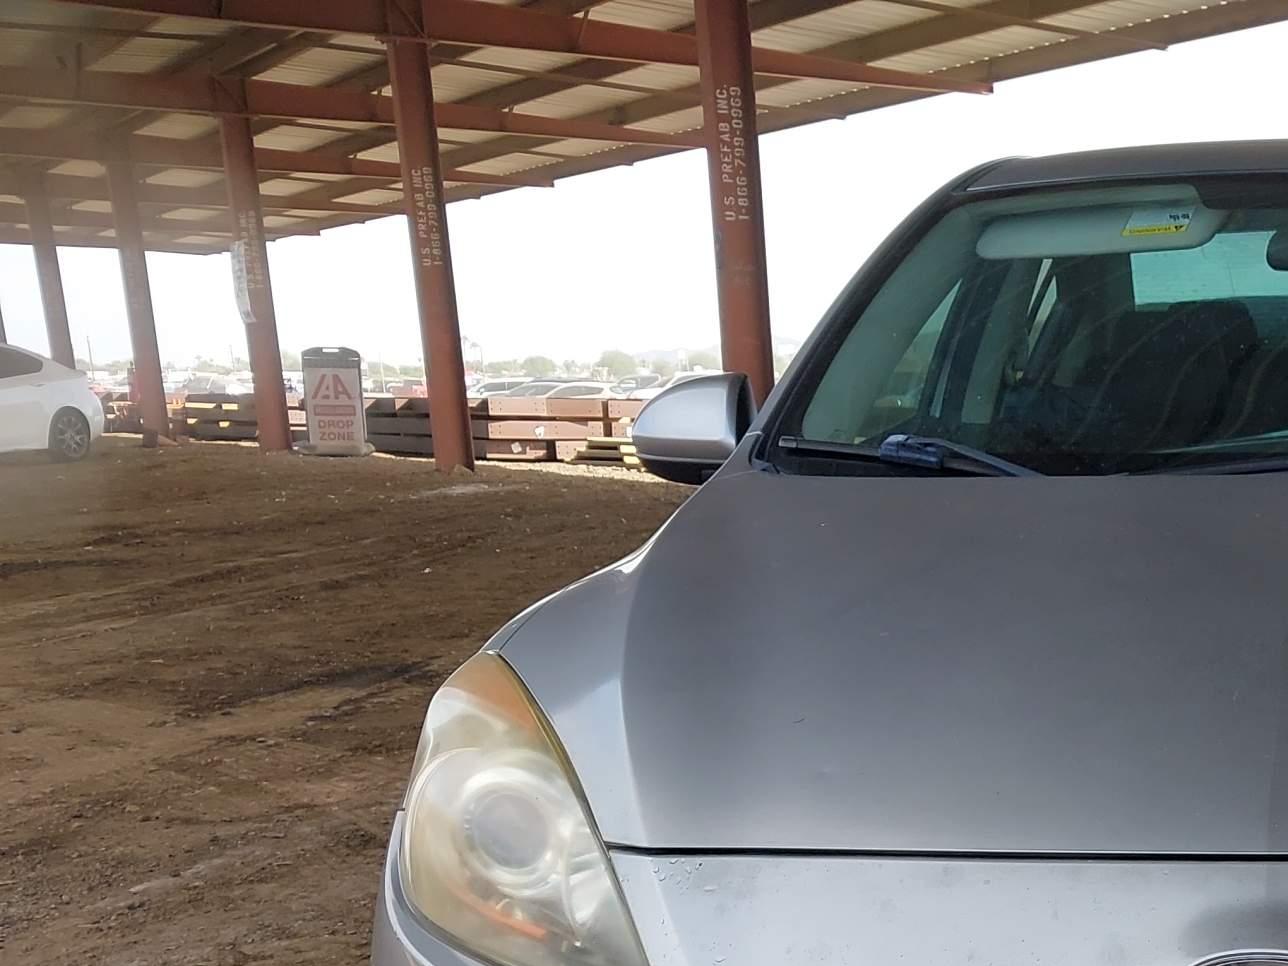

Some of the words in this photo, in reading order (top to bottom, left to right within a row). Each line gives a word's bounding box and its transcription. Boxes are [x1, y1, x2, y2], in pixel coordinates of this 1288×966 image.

[716, 84, 729, 114] INC.
[719, 122, 734, 183] PREFAB
[729, 86, 750, 220] 1-866-799-0969
[414, 193, 428, 239] PREFAB
[318, 419, 354, 430] DROP
[319, 431, 355, 441] ZONE
